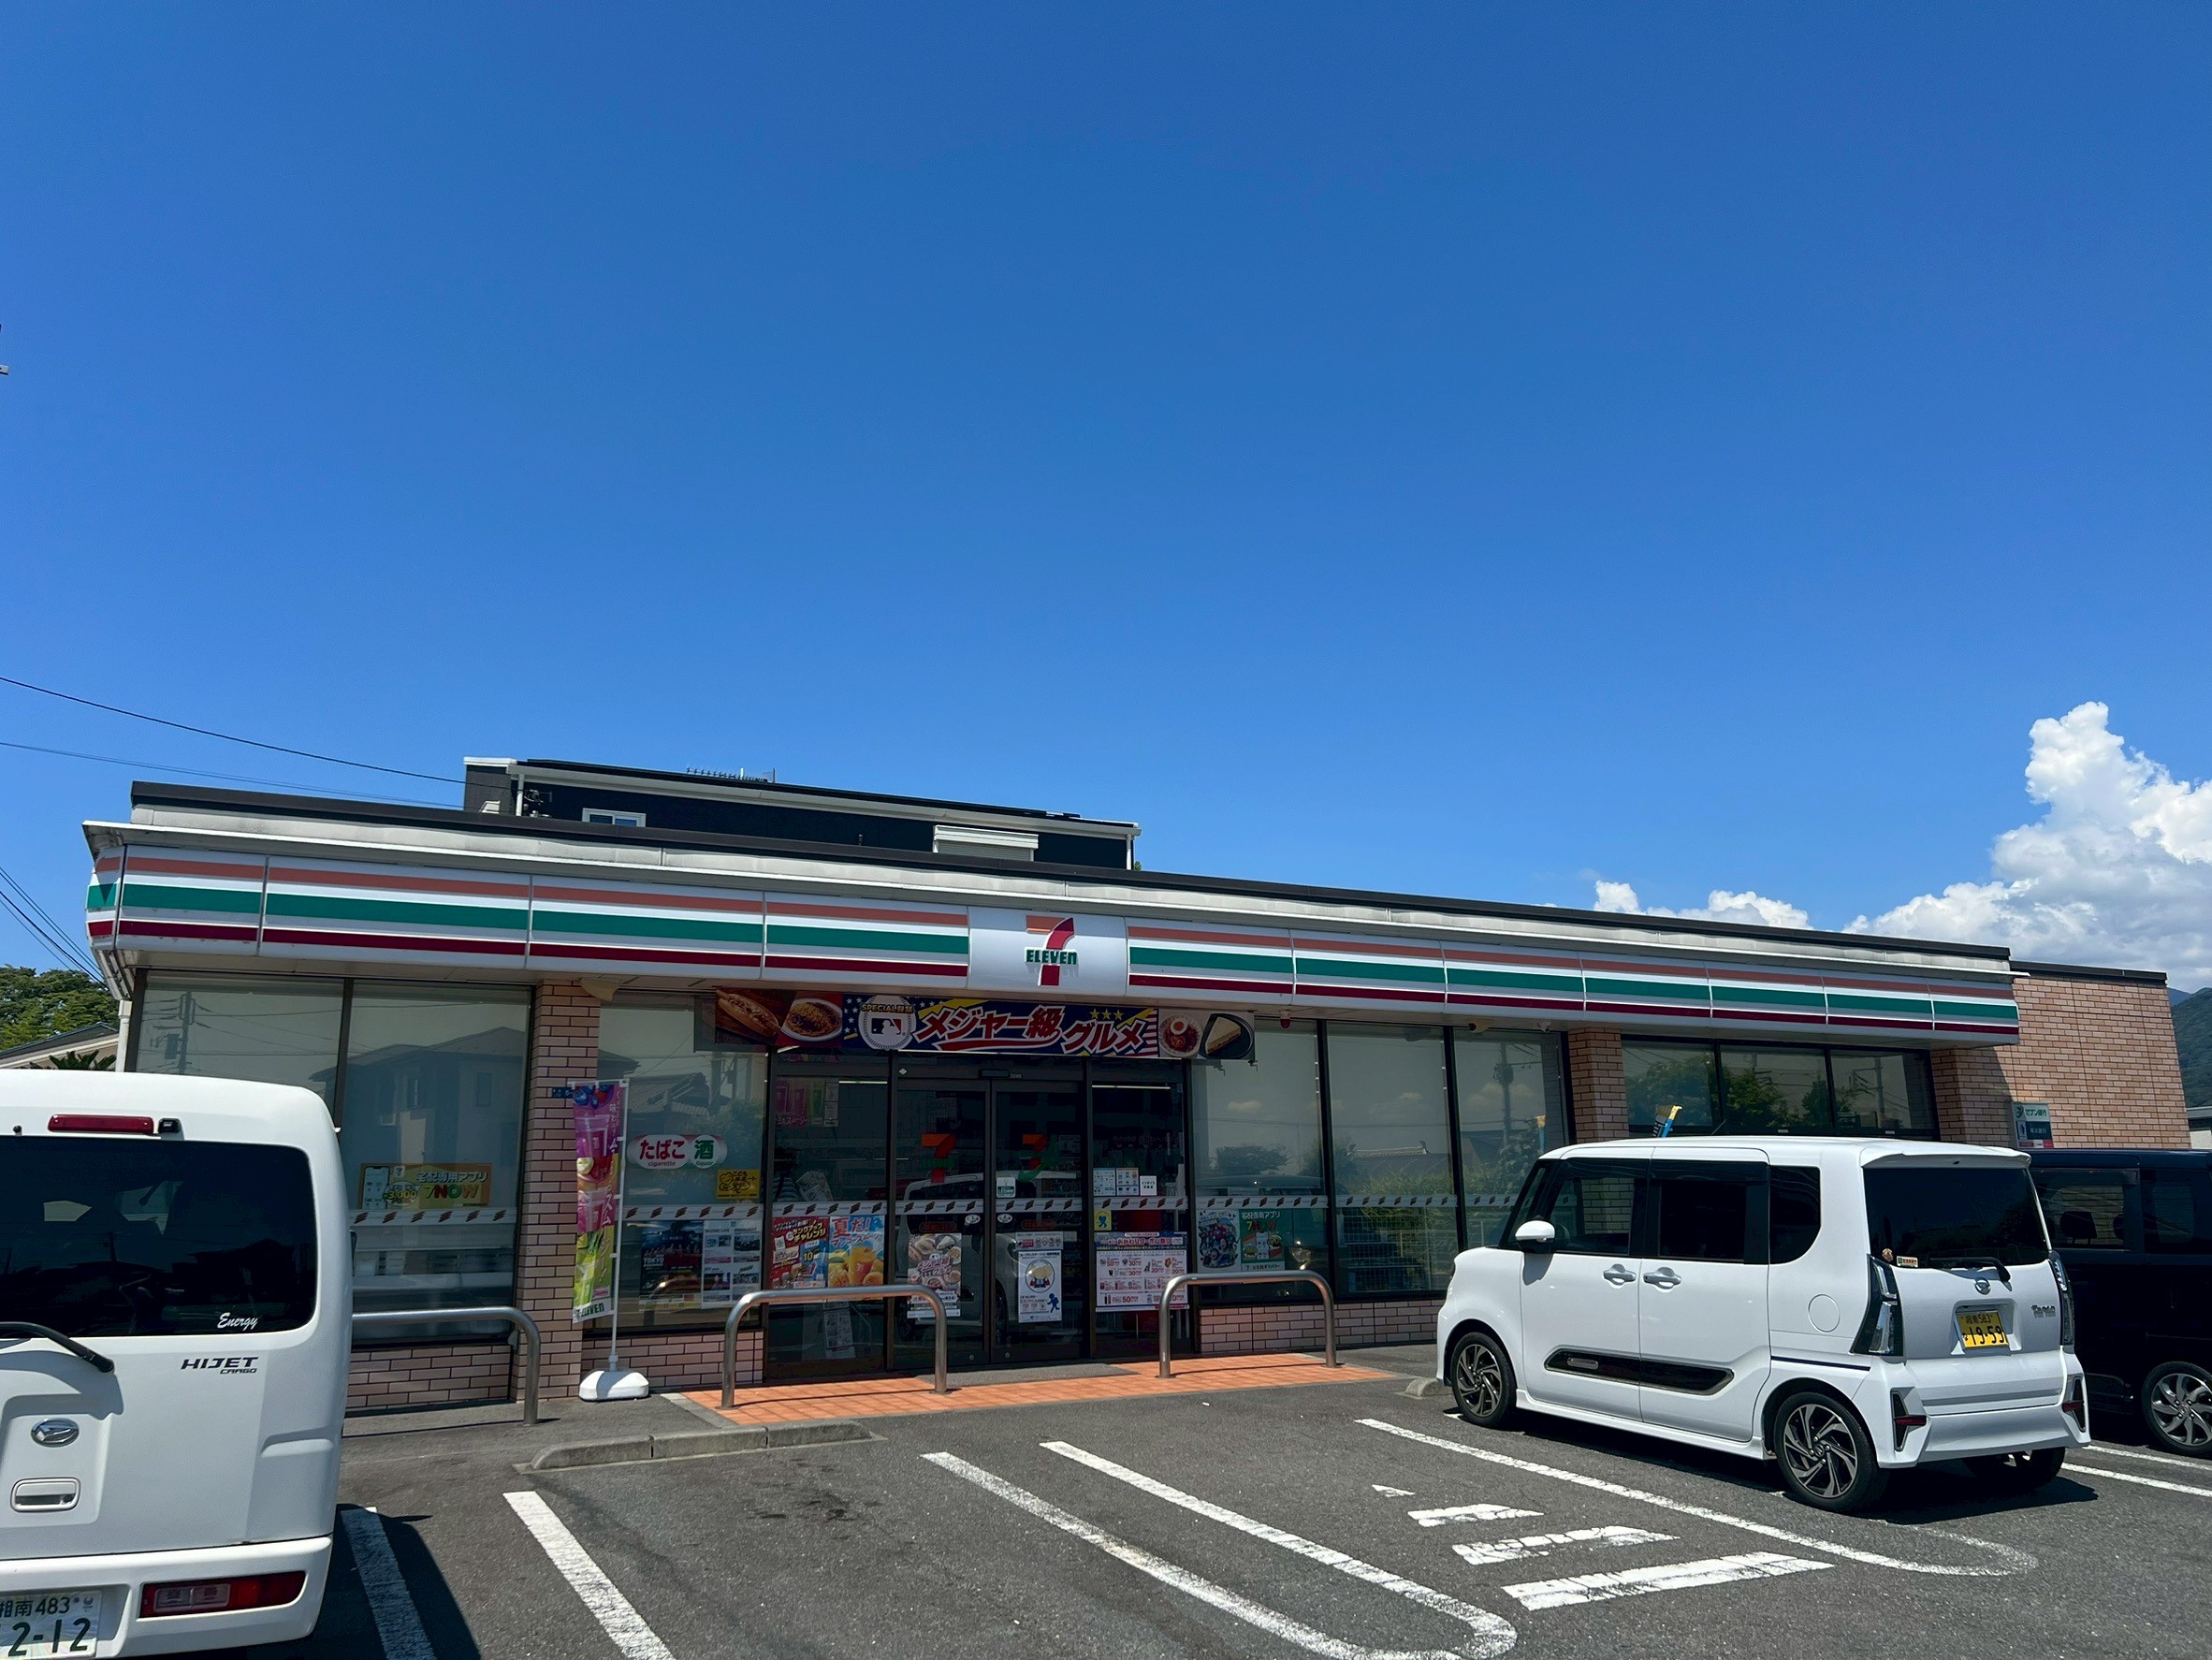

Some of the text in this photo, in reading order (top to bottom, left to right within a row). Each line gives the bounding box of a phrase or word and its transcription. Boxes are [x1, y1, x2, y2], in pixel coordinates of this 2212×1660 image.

[911, 1005, 1066, 1044] メジャー級
[1059, 1020, 1146, 1055] グルメ
[639, 1139, 714, 1160] たばこ 酒
[217, 1312, 258, 1332] Energy
[181, 1357, 259, 1370] HIJET
[36, 1596, 70, 1616] 483
